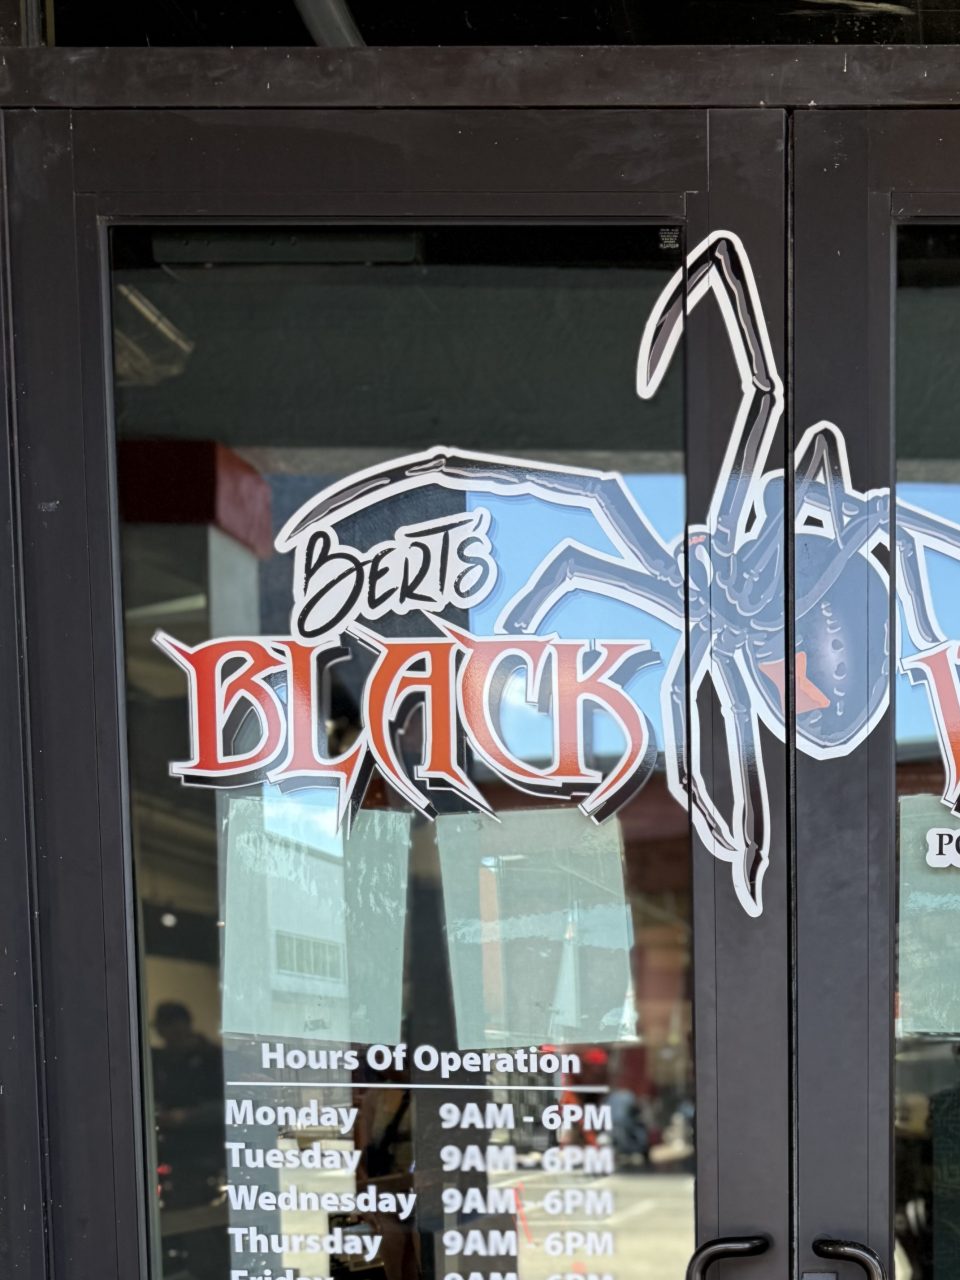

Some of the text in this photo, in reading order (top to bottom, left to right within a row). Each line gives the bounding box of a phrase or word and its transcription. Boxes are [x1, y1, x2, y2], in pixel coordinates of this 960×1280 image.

[298, 513, 492, 640] BERTS
[152, 628, 662, 840] BLACK
[260, 1043, 581, 1077] Hours Of Operation
[225, 1100, 359, 1133] Monday
[439, 1103, 516, 1130] 9AM
[541, 1104, 613, 1131] 6PM
[226, 1143, 362, 1175] Tuesday
[440, 1145, 516, 1172] 9AM
[541, 1146, 615, 1174] 6PM
[226, 1184, 417, 1219] Wednesday
[442, 1188, 517, 1214] 9AM
[543, 1189, 615, 1216] 6PM
[228, 1227, 383, 1261] Thursday
[442, 1230, 518, 1256] 9AM
[543, 1231, 615, 1257] 6PM
